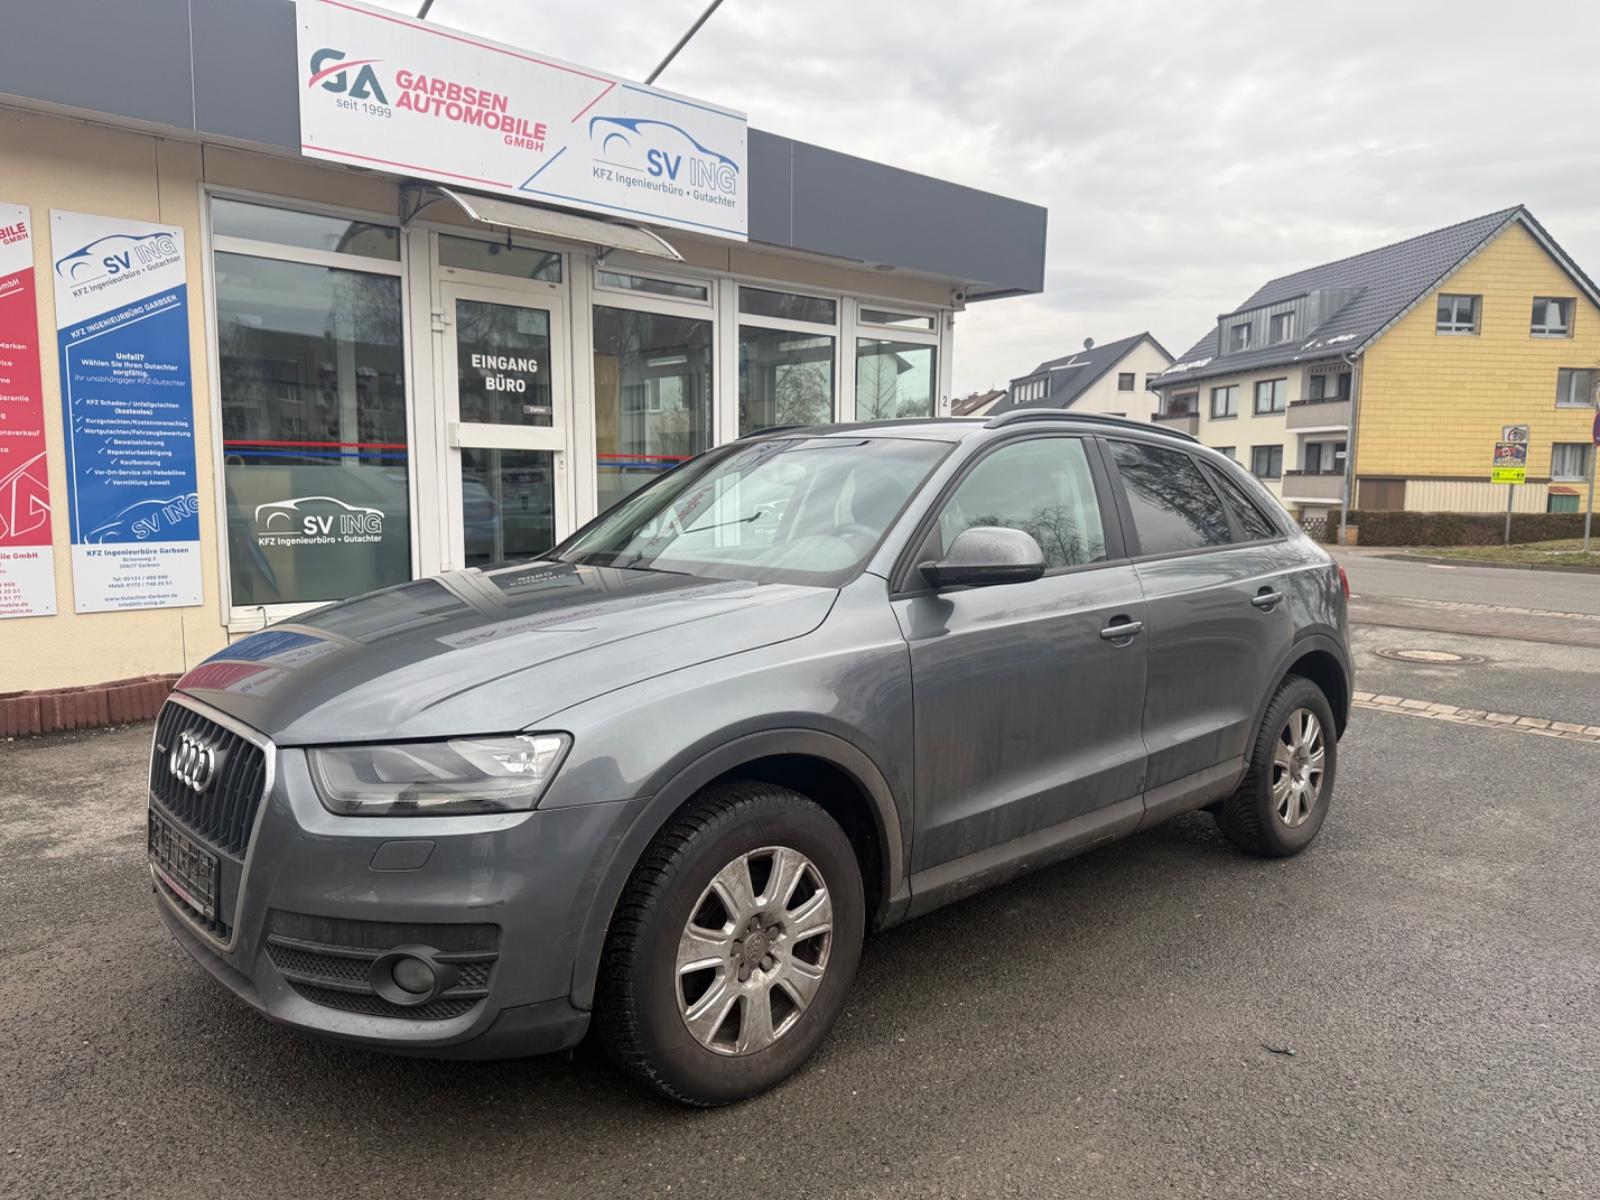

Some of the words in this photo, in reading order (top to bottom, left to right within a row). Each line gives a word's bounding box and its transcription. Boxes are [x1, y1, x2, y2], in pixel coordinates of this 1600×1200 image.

[395, 69, 509, 113] GARBSEN
[336, 98, 358, 111] seit
[362, 103, 392, 119] 1999
[395, 91, 547, 141] AUTOMOBILE
[503, 135, 544, 153] GMBH
[647, 148, 682, 181] SV
[689, 157, 736, 196] ING
[593, 167, 613, 181] KFZ
[615, 172, 684, 197] Ingenieurbüro
[693, 190, 736, 208] Gutachter
[3, 232, 28, 245] GMBH
[103, 250, 131, 274] SV
[134, 238, 178, 264] ING
[72, 287, 89, 298] KFZ
[90, 268, 141, 292] Ingenieurbüro
[147, 255, 181, 271] Gutachter
[70, 329, 87, 339] KFZ
[87, 306, 144, 332] INGENIEURBÜRO
[144, 294, 177, 311] GARBSEN
[81, 359, 110, 367] Wählen
[111, 360, 122, 368] Sie
[144, 362, 178, 371] Gutachter
[116, 352, 145, 360] Unfall?
[471, 353, 538, 373] EINGANG
[485, 374, 526, 393] BÜRO
[942, 395, 948, 408] 2
[132, 513, 160, 539] SV
[303, 515, 333, 535] SV
[340, 514, 382, 534] ING
[258, 538, 276, 546] KFZ
[278, 536, 336, 546] Ingenieurbüro
[343, 535, 382, 543] Gutachter
[104, 548, 157, 557] Ingenieurbüro
